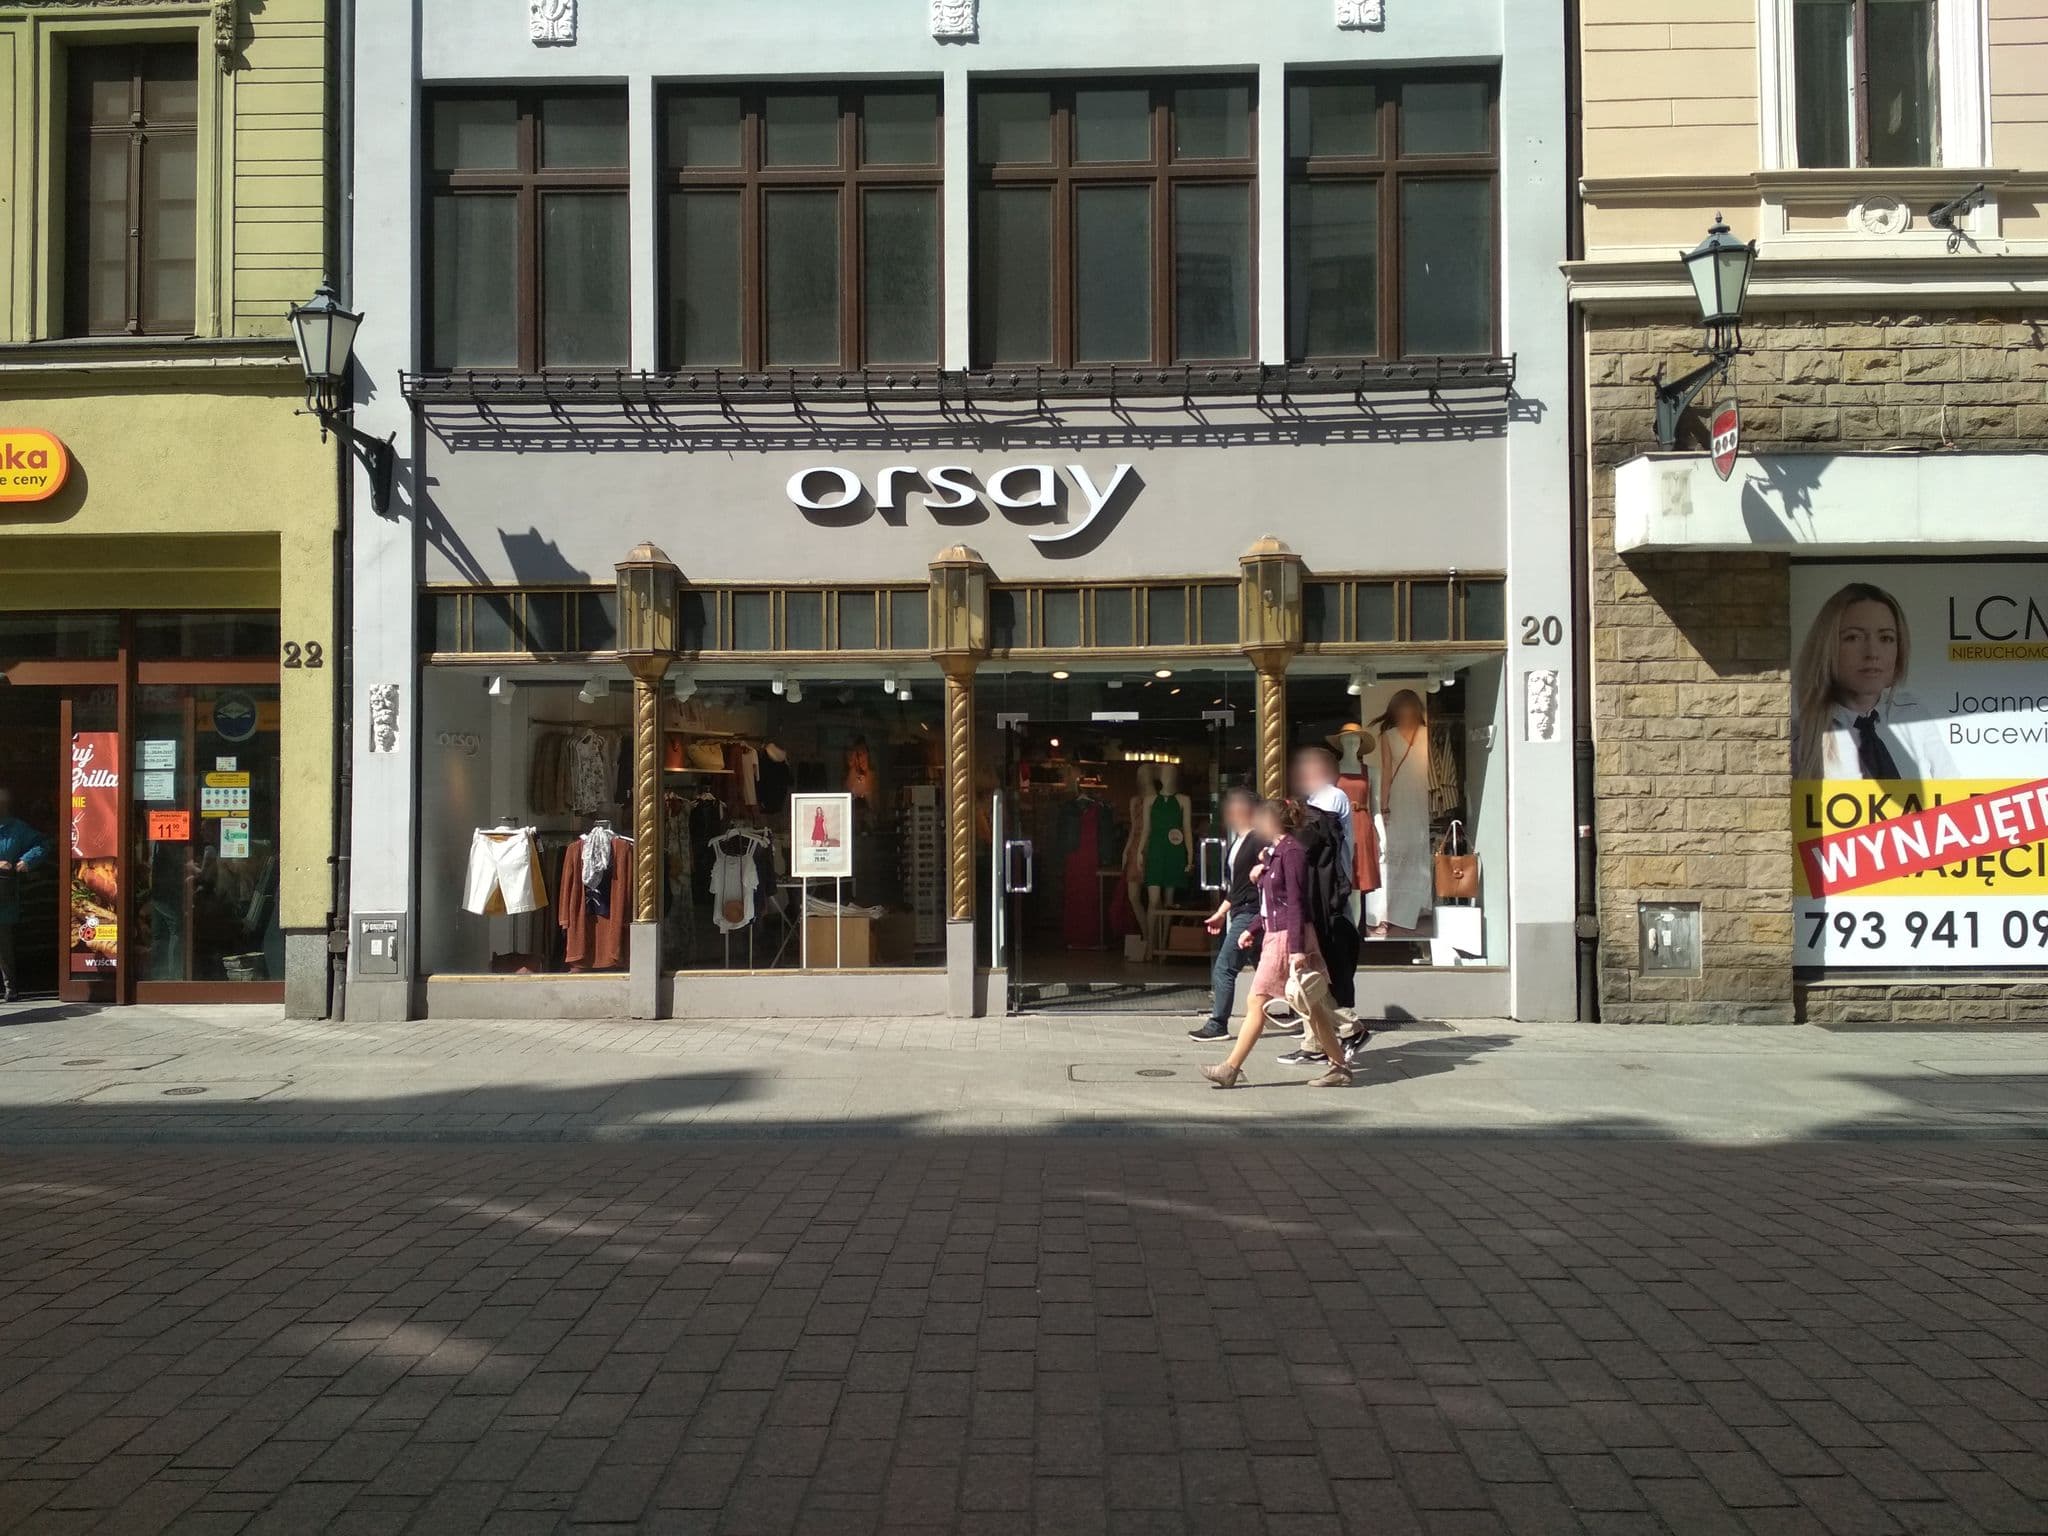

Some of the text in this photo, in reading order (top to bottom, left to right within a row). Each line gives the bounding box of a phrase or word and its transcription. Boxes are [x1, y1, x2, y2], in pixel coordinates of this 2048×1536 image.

[0, 443, 48, 469] ka
[13, 476, 47, 487] ceny
[786, 463, 1133, 542] orsay
[1520, 615, 1563, 646] 20
[283, 640, 324, 669] 22
[158, 823, 171, 838] 11
[1805, 911, 1887, 949] 793
[1905, 911, 1979, 949] 941
